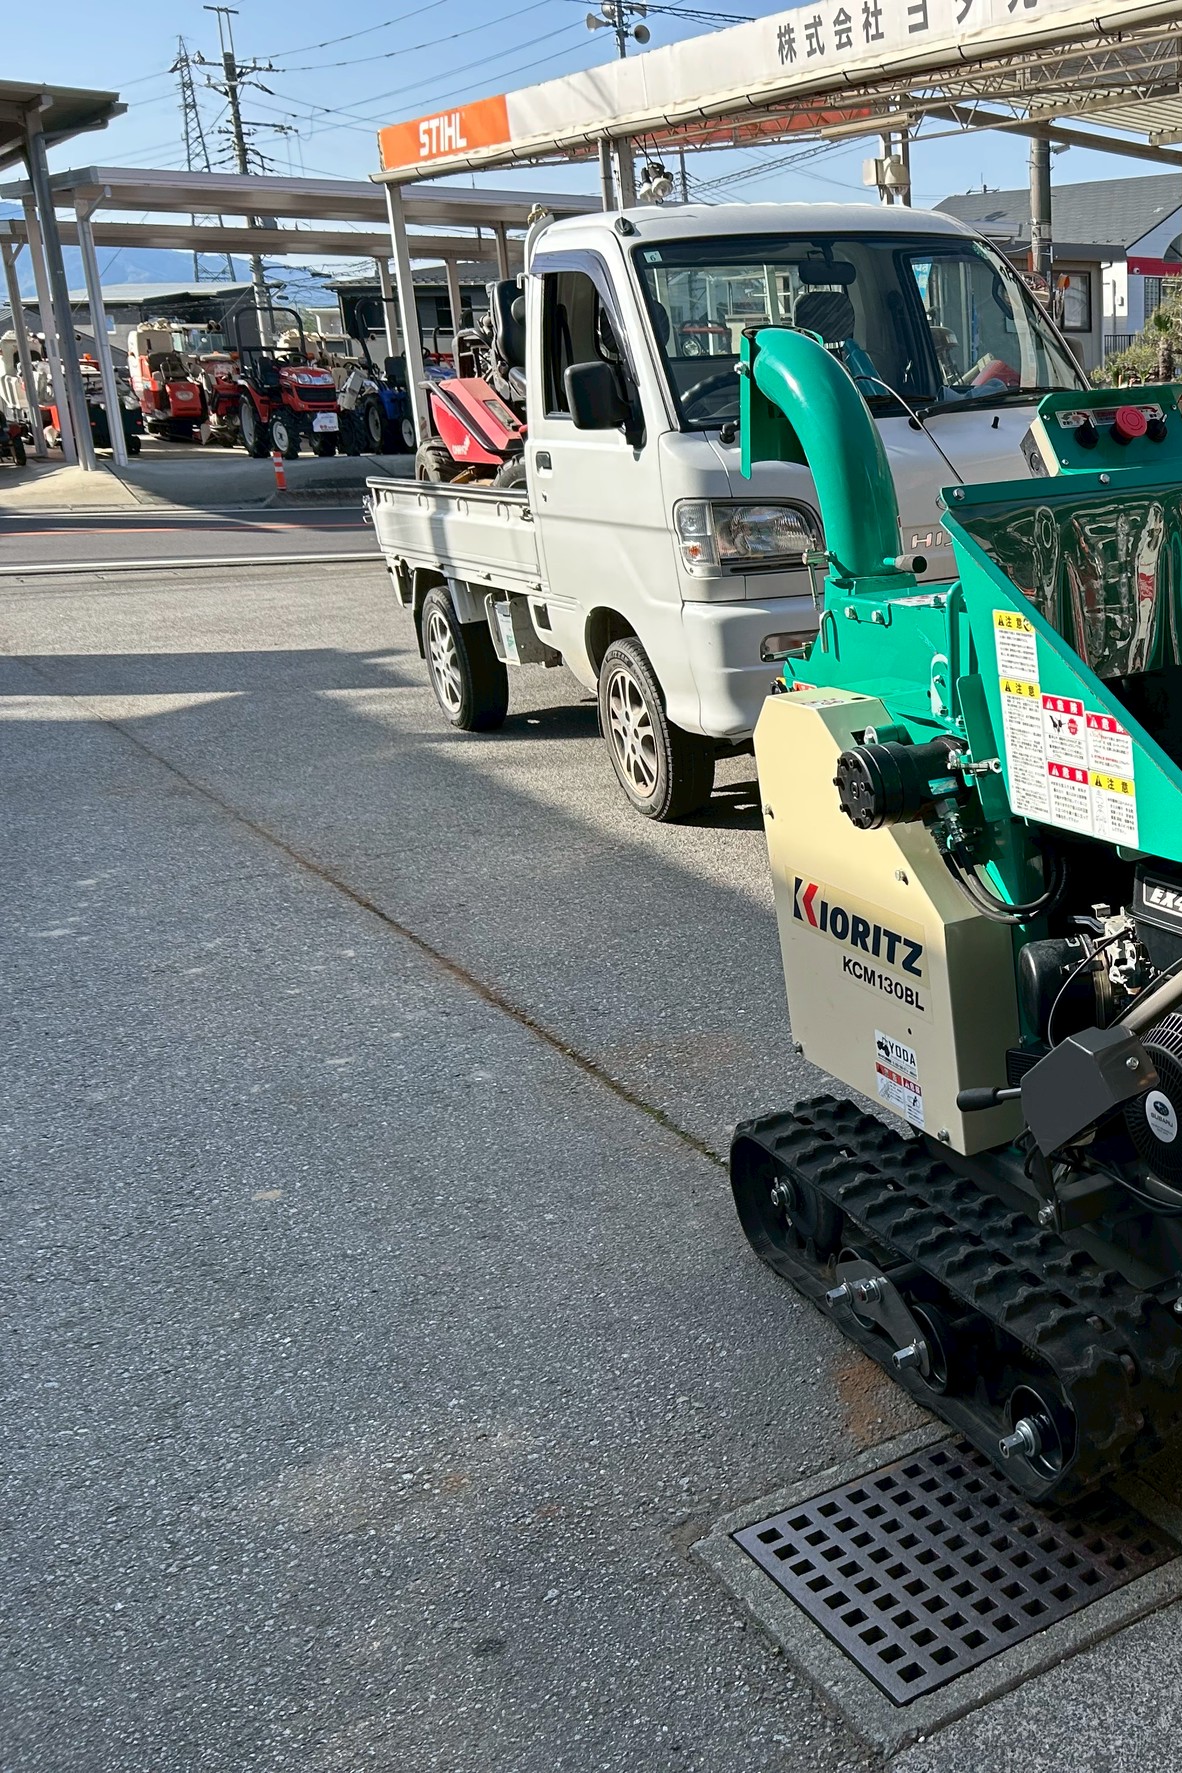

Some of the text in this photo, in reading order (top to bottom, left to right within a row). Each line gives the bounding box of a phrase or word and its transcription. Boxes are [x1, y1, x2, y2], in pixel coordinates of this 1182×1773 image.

[777, 0, 1037, 65] 株式会社ヨ
[419, 112, 467, 157] STIHL
[911, 530, 954, 549] HI
[1005, 614, 1023, 629] 注意
[1015, 682, 1036, 698] 注意
[1056, 699, 1078, 715] 危険
[1062, 766, 1084, 783] 危険
[1107, 776, 1130, 793] 注意
[793, 876, 923, 978] KIORITZ
[843, 955, 925, 1012] KCM130BL
[888, 1041, 916, 1067] YODA
[1150, 1111, 1174, 1128] SUBARU
